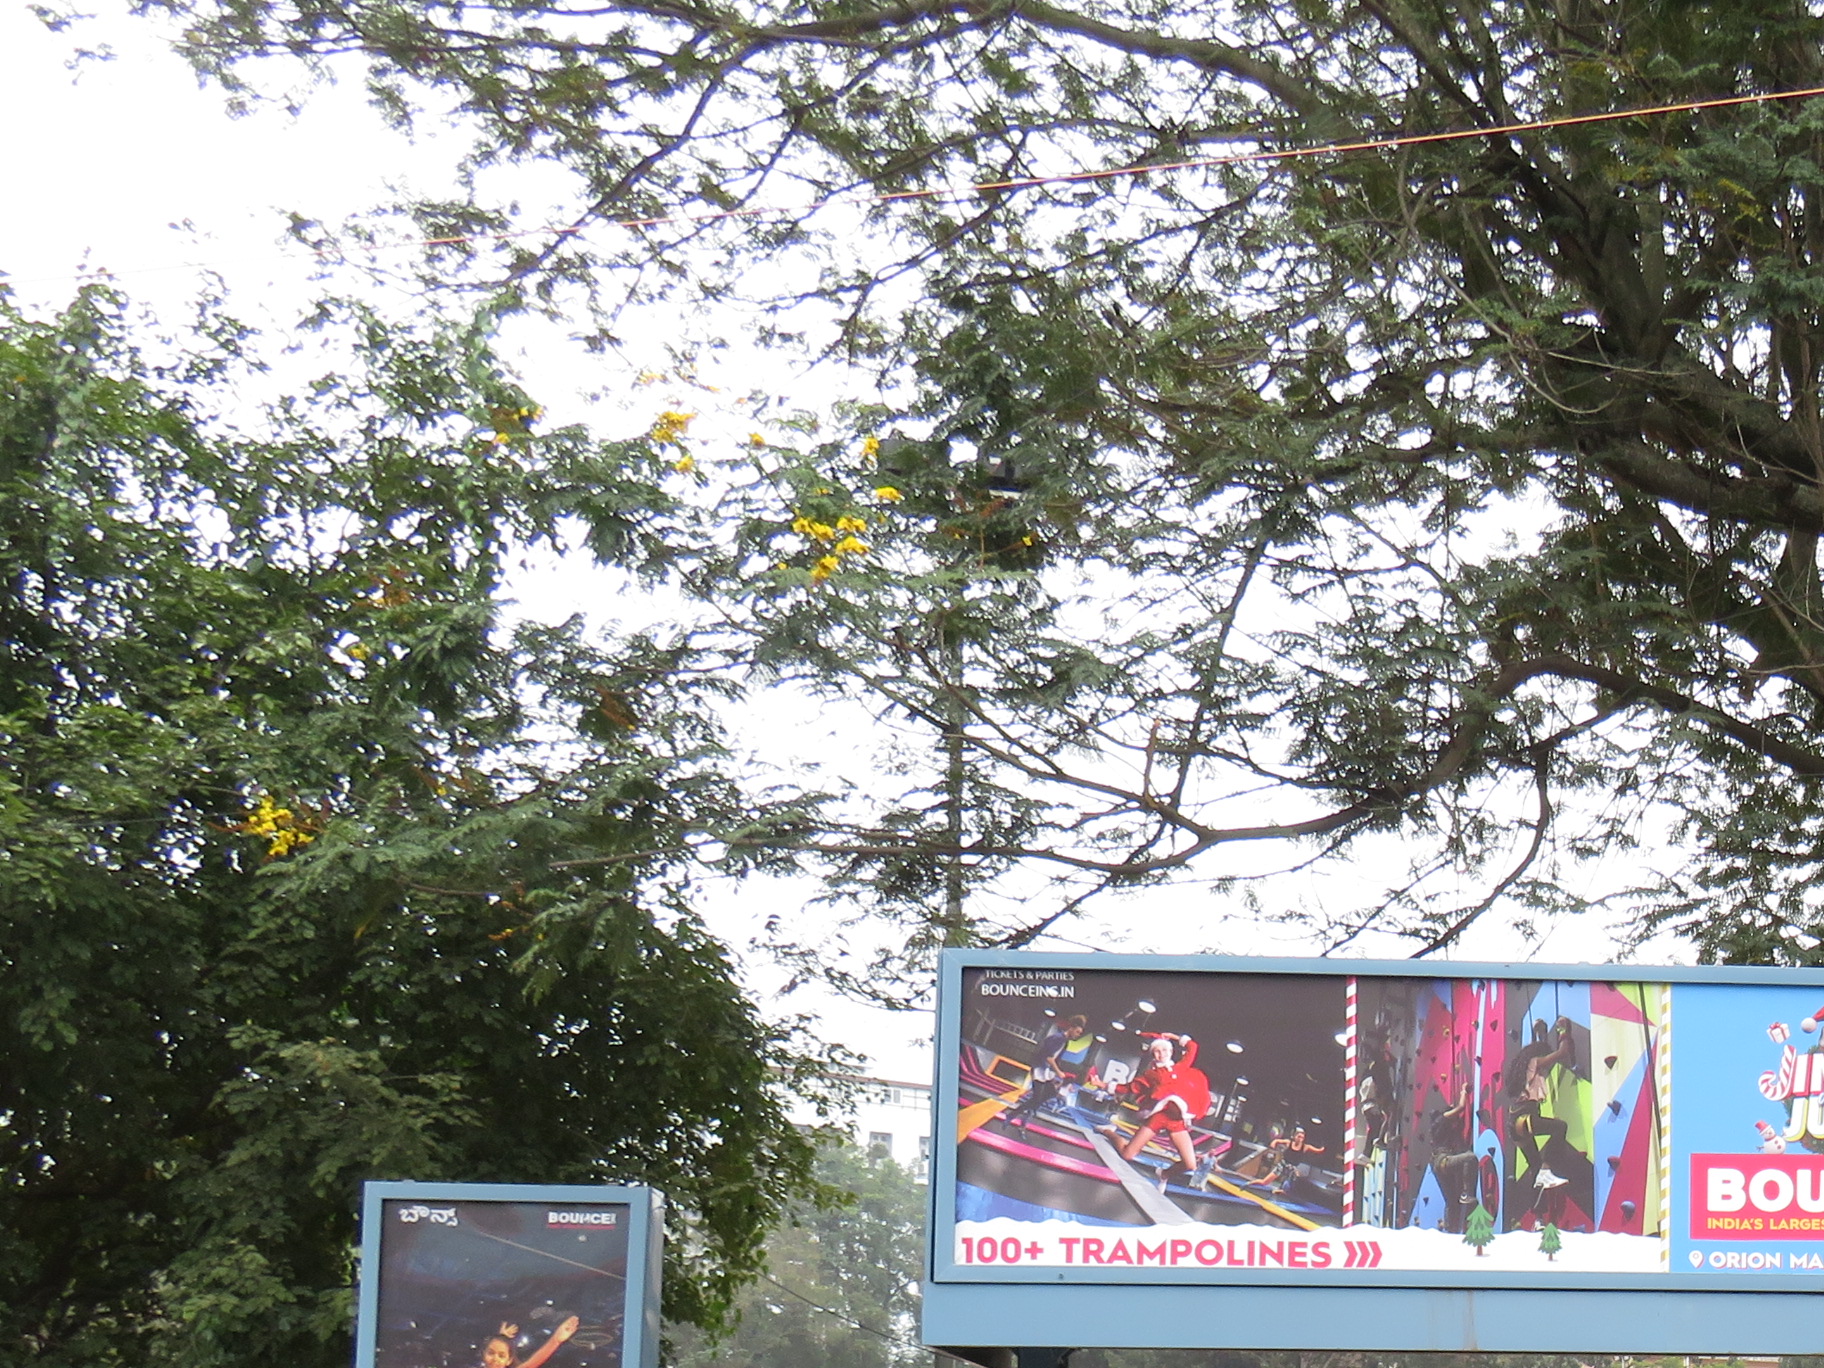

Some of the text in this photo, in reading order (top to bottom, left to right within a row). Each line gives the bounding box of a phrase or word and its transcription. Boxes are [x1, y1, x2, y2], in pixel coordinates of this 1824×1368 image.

[1035, 971, 1075, 981] PARTIES
[981, 984, 1075, 998] BOUNCEINC.IN
[961, 1236, 1332, 1268] 100+ TRAMPOLINES
[1708, 1250, 1782, 1269] ORION
